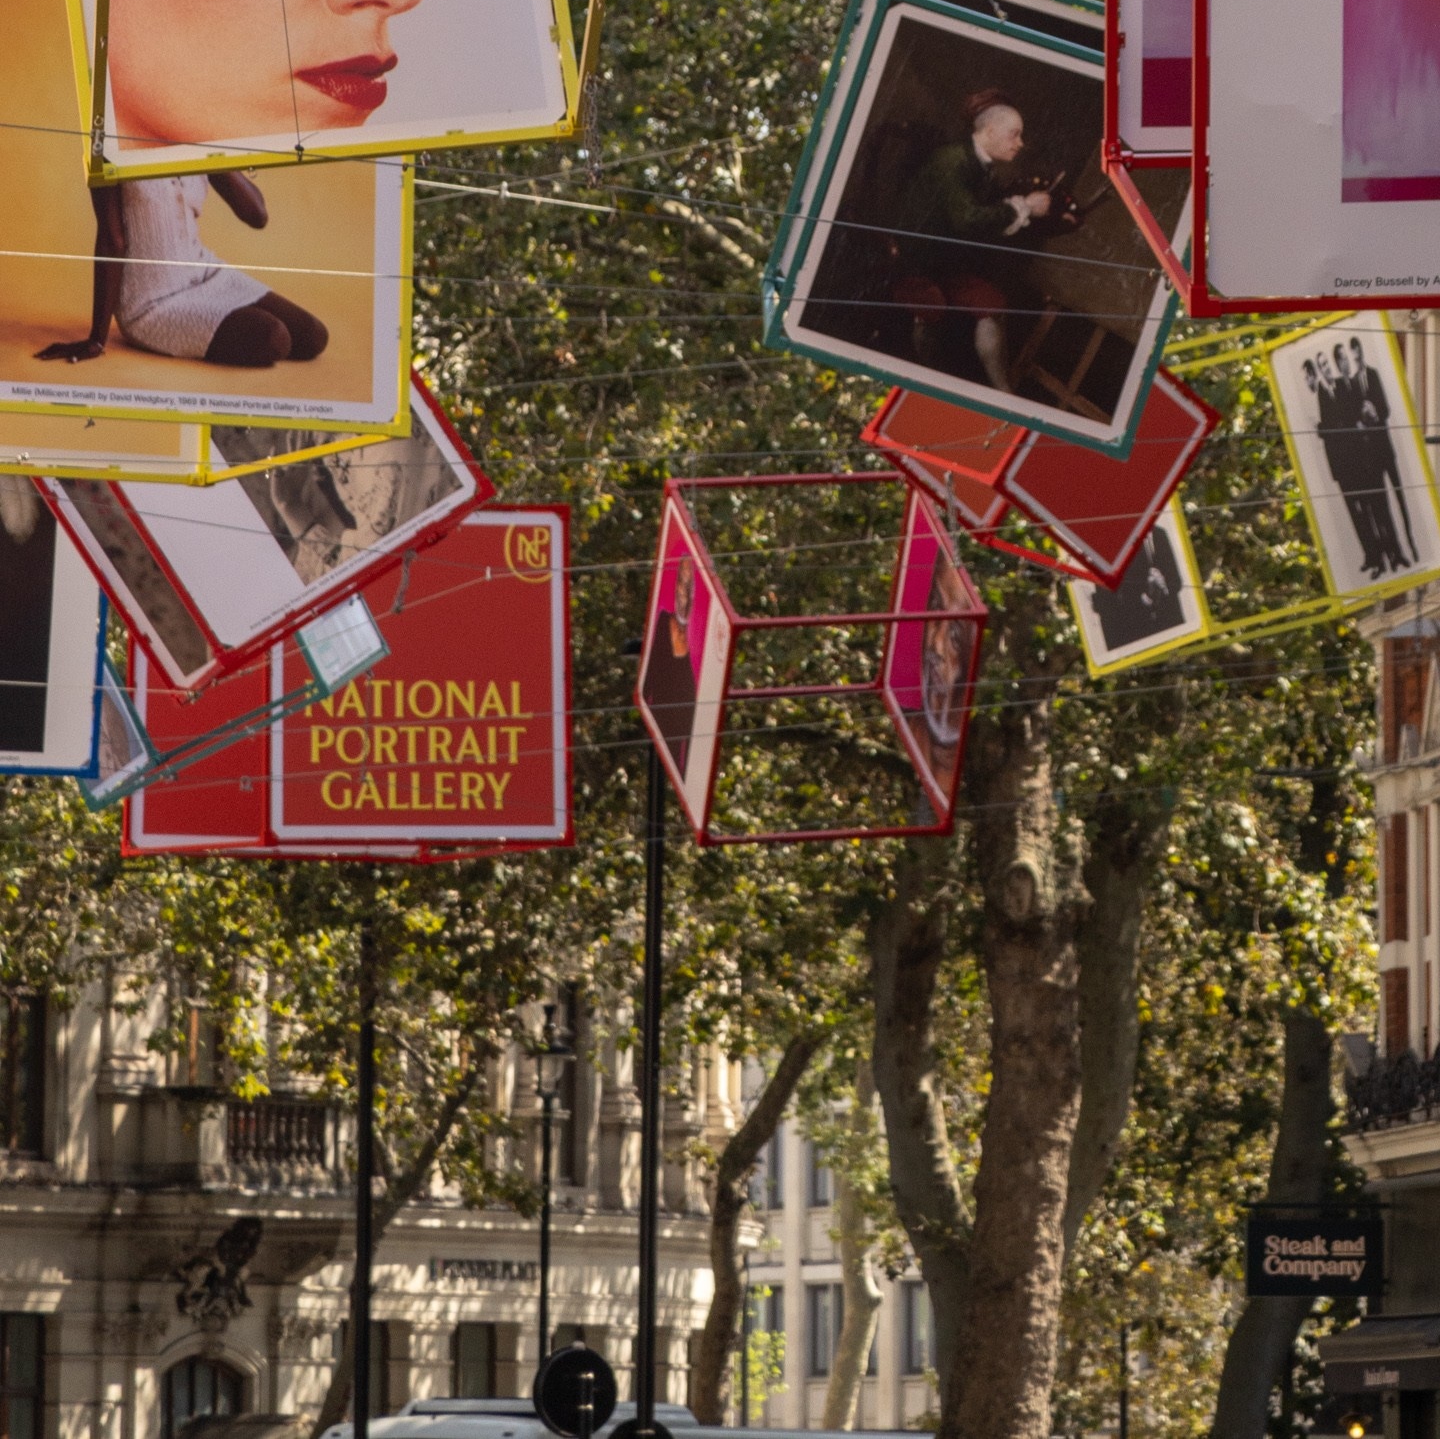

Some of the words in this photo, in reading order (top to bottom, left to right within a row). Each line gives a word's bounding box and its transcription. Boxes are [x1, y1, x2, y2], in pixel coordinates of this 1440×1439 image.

[1334, 277, 1373, 289] Darcey
[1375, 275, 1414, 287] Bussell
[1416, 274, 1430, 287] by
[97, 391, 108, 402] by
[109, 391, 133, 401] David
[209, 397, 241, 408] National
[242, 399, 272, 410] Portrait
[273, 401, 301, 412] Gallery,
[303, 402, 334, 413] London
[309, 724, 528, 765] PORTRAIT
[320, 770, 512, 811] GALLERY
[1263, 1234, 1329, 1256] Steak
[1330, 1234, 1366, 1256] and
[1262, 1254, 1367, 1282] Company
